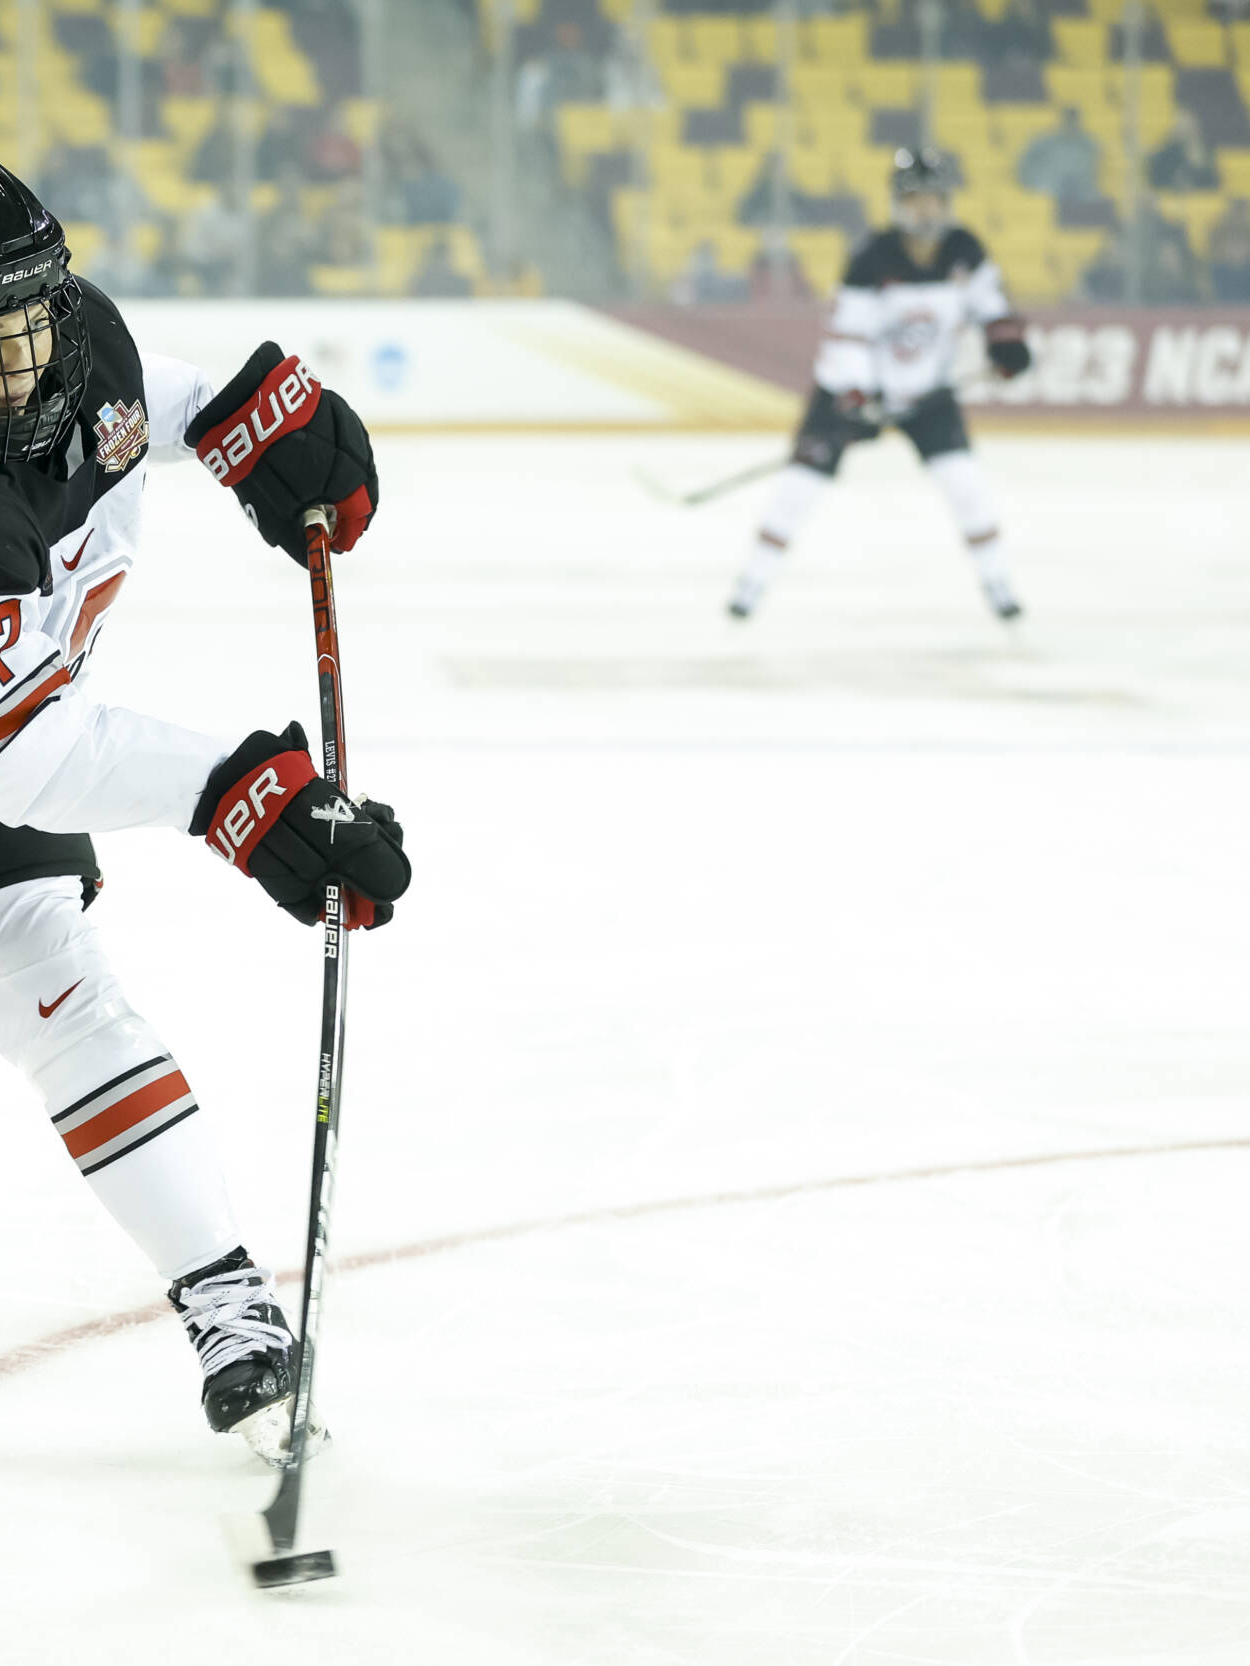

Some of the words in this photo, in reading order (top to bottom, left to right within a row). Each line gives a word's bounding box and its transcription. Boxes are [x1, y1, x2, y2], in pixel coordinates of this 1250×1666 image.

[1, 259, 53, 285] BAUER
[1143, 322, 1250, 404] NC
[99, 426, 128, 459] FROZEN
[125, 409, 141, 432] FOUR
[203, 361, 322, 481] BAUER
[325, 740, 336, 767] LEVIS
[326, 768, 337, 783] #27
[324, 885, 339, 959] BAUER
[317, 1052, 332, 1123] HYPERLITE
